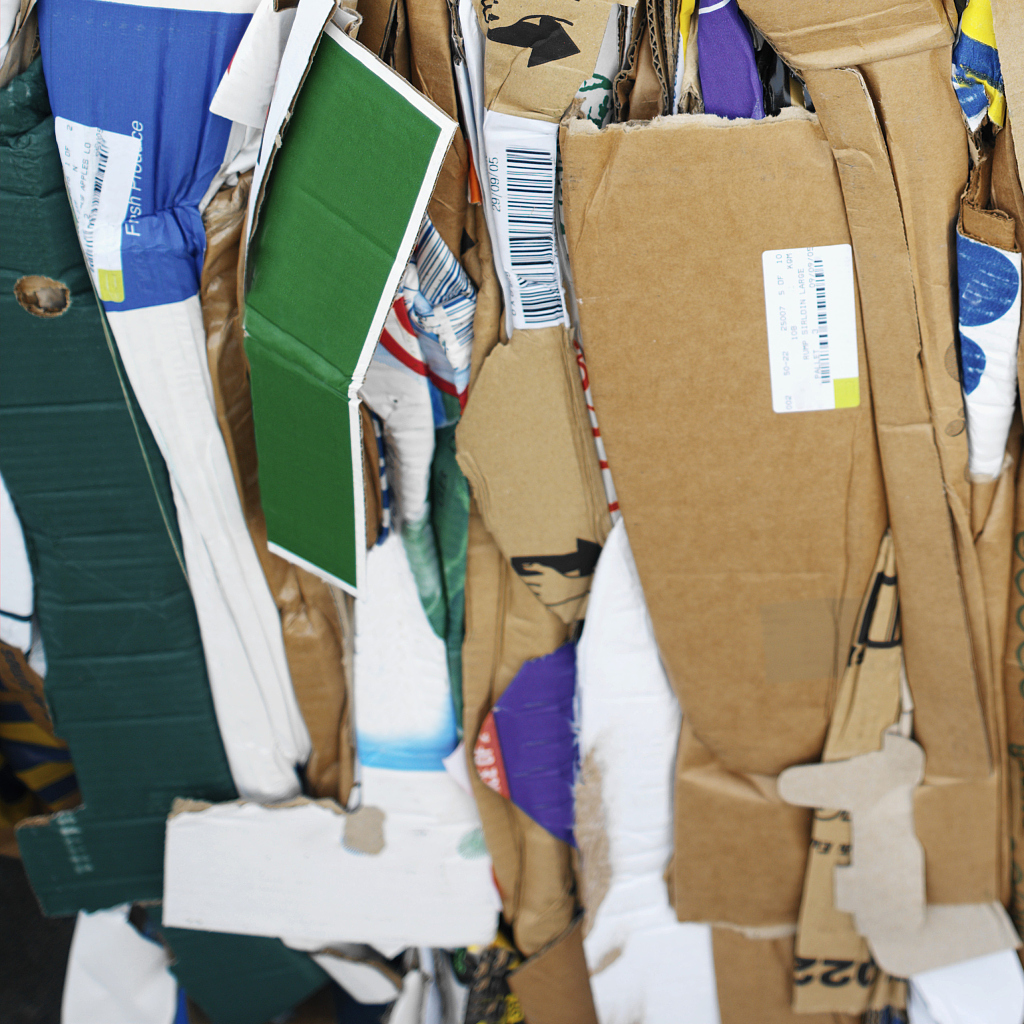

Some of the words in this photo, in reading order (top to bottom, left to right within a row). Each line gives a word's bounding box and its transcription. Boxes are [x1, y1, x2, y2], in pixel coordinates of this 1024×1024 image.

[80, 159, 89, 191] APPLES
[488, 157, 502, 212] 29/09/05
[777, 275, 785, 286] OF
[797, 267, 806, 295] LARGE
[800, 298, 809, 335] SIRLOIN
